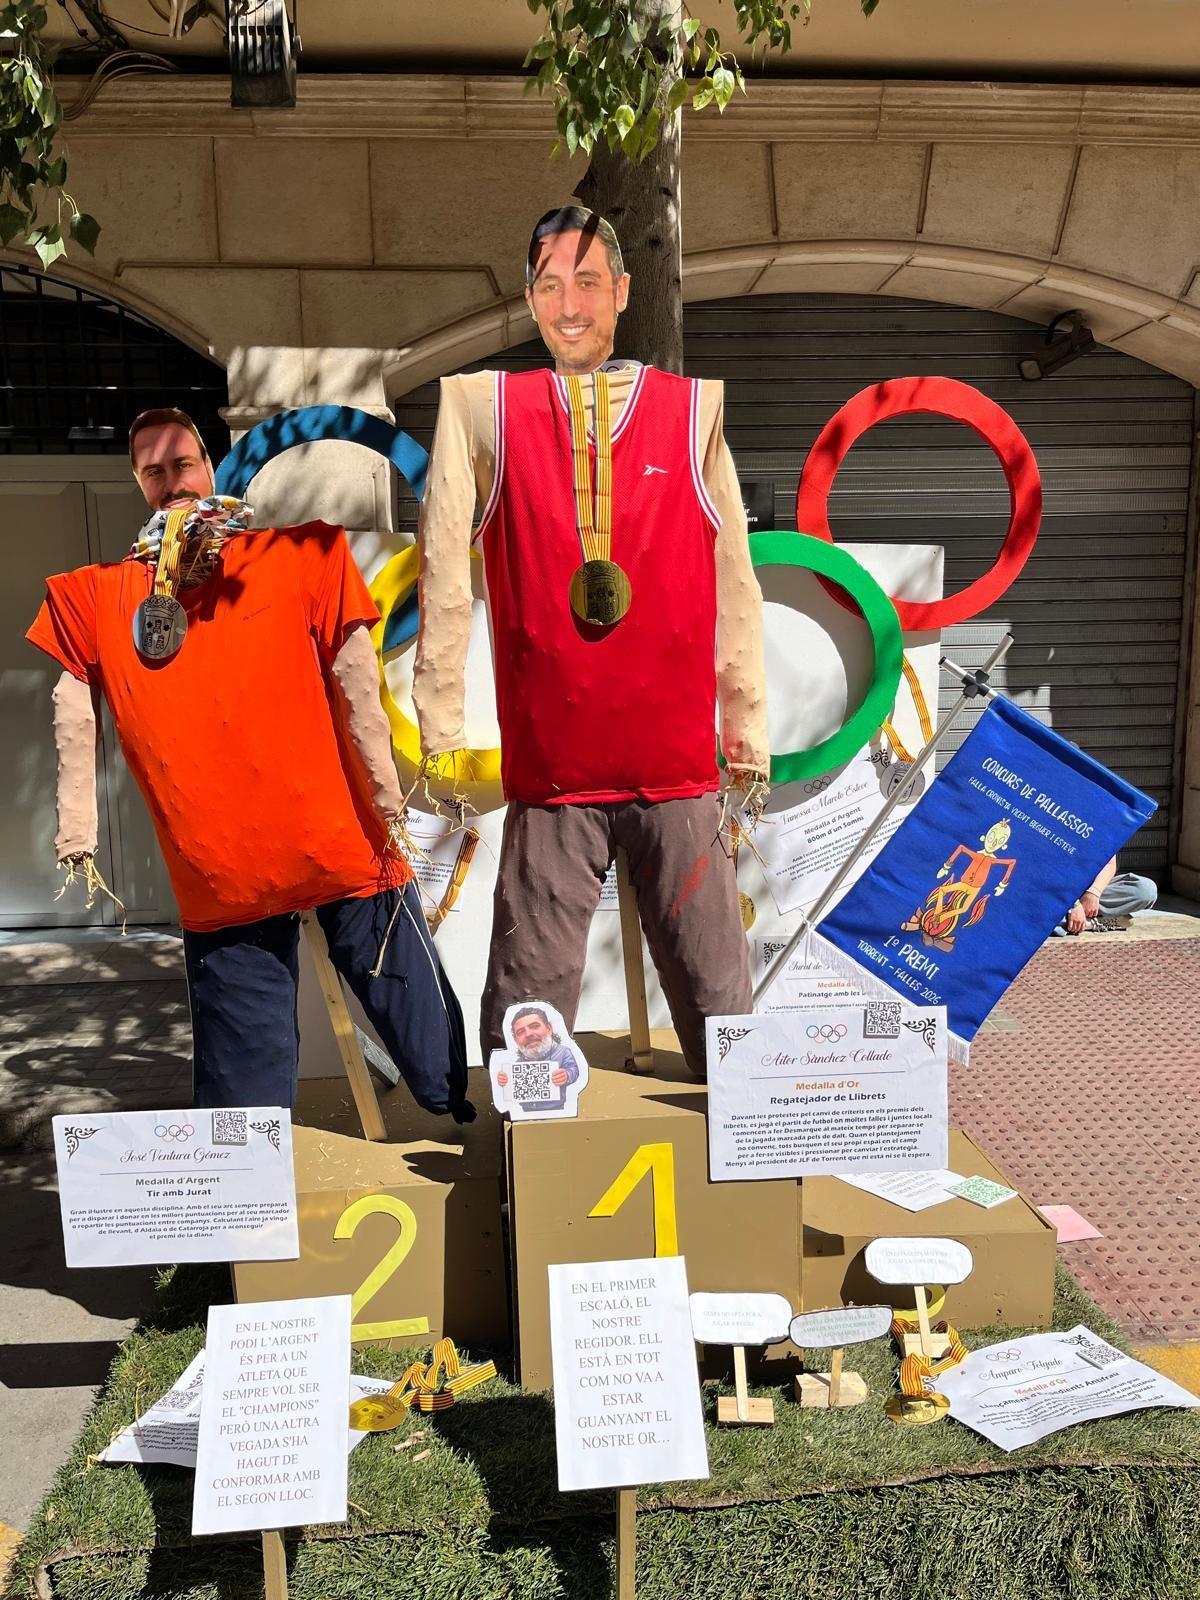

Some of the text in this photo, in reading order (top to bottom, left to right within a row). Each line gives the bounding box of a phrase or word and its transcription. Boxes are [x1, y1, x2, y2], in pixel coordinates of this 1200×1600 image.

[981, 757, 1093, 838] CONCURS DE PALLASSOS
[967, 776, 986, 792] FALLA
[985, 789, 1011, 809] CRONISTA
[1010, 806, 1030, 823] VICENT
[1053, 836, 1076, 854] ESTEVE
[803, 820, 830, 835] Medalla
[806, 832, 826, 843] 800m
[842, 814, 863, 827] Somni
[897, 943, 939, 980] PREMI
[857, 939, 888, 966] TORRENT
[893, 967, 922, 991] FALLES
[919, 987, 941, 1009] 2026
[761, 1051, 798, 1066] Aitor
[795, 1080, 859, 1090] Medalla d'Or
[770, 1092, 885, 1105] Regatejador de Llibrets
[120, 1150, 147, 1163] José
[149, 1148, 191, 1162] Ventura
[135, 1176, 220, 1185] Medalla d'Argent
[588, 1143, 678, 1258] 1
[333, 1194, 429, 1343] 2
[571, 1277, 656, 1294] EN EL PRIMER
[579, 1295, 651, 1311] ESCALÓ, EL
[235, 1317, 314, 1333] EN EL NOSTRE
[591, 1315, 641, 1329] NOSTRE
[230, 1332, 318, 1350] PODI L'ARGENT
[574, 1332, 662, 1349] REGIDOR. ELL
[239, 1350, 307, 1365] ÉS PER A UN
[579, 1351, 660, 1368] ESTÀ EN TOT
[236, 1366, 307, 1382] ATLETA QUE
[579, 1370, 664, 1388] COM NO VA A
[222, 1382, 319, 1400] SEMPRE VOL SER
[602, 1391, 643, 1406] ESTAR
[221, 1399, 318, 1417] EL "CHAMPIONS"
[219, 1416, 319, 1435] PERÒ UNA ALTRA
[577, 1409, 671, 1428] GUANYANT EL
[229, 1434, 308, 1452] VEGADA S'HA
[581, 1433, 634, 1449] NOSTRE
[237, 1453, 298, 1469] HAGUT DE
[212, 1469, 320, 1489] CONFORMAR AMB
[217, 1488, 313, 1506] EL SEGON LLOC.
